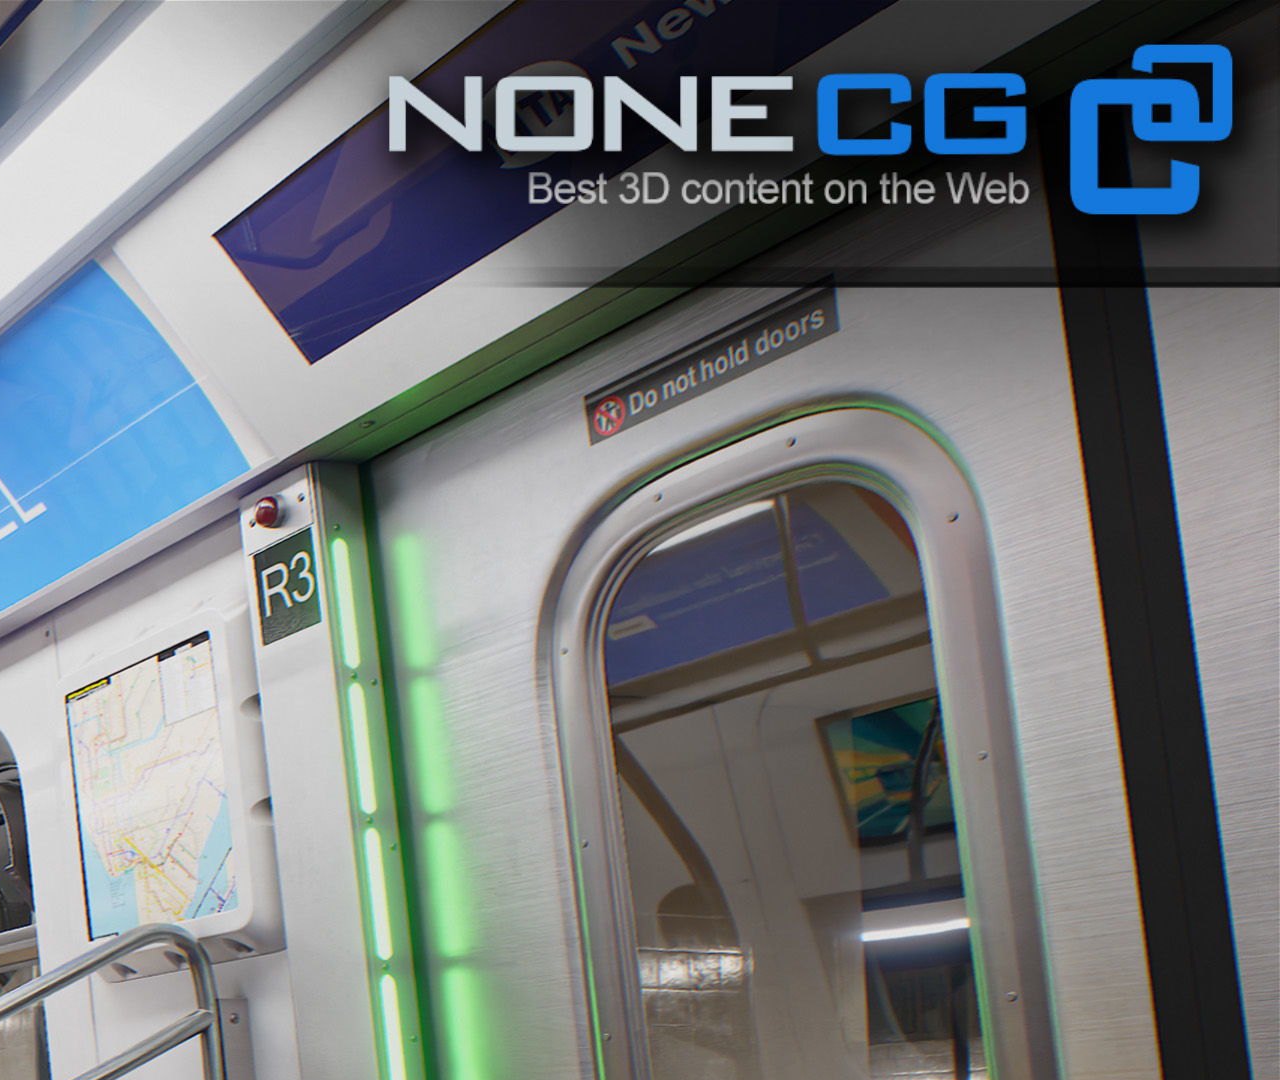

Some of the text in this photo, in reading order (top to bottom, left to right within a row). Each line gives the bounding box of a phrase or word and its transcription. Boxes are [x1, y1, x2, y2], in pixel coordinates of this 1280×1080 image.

[627, 308, 826, 416] Do not hold doors
[260, 551, 316, 618] R3
